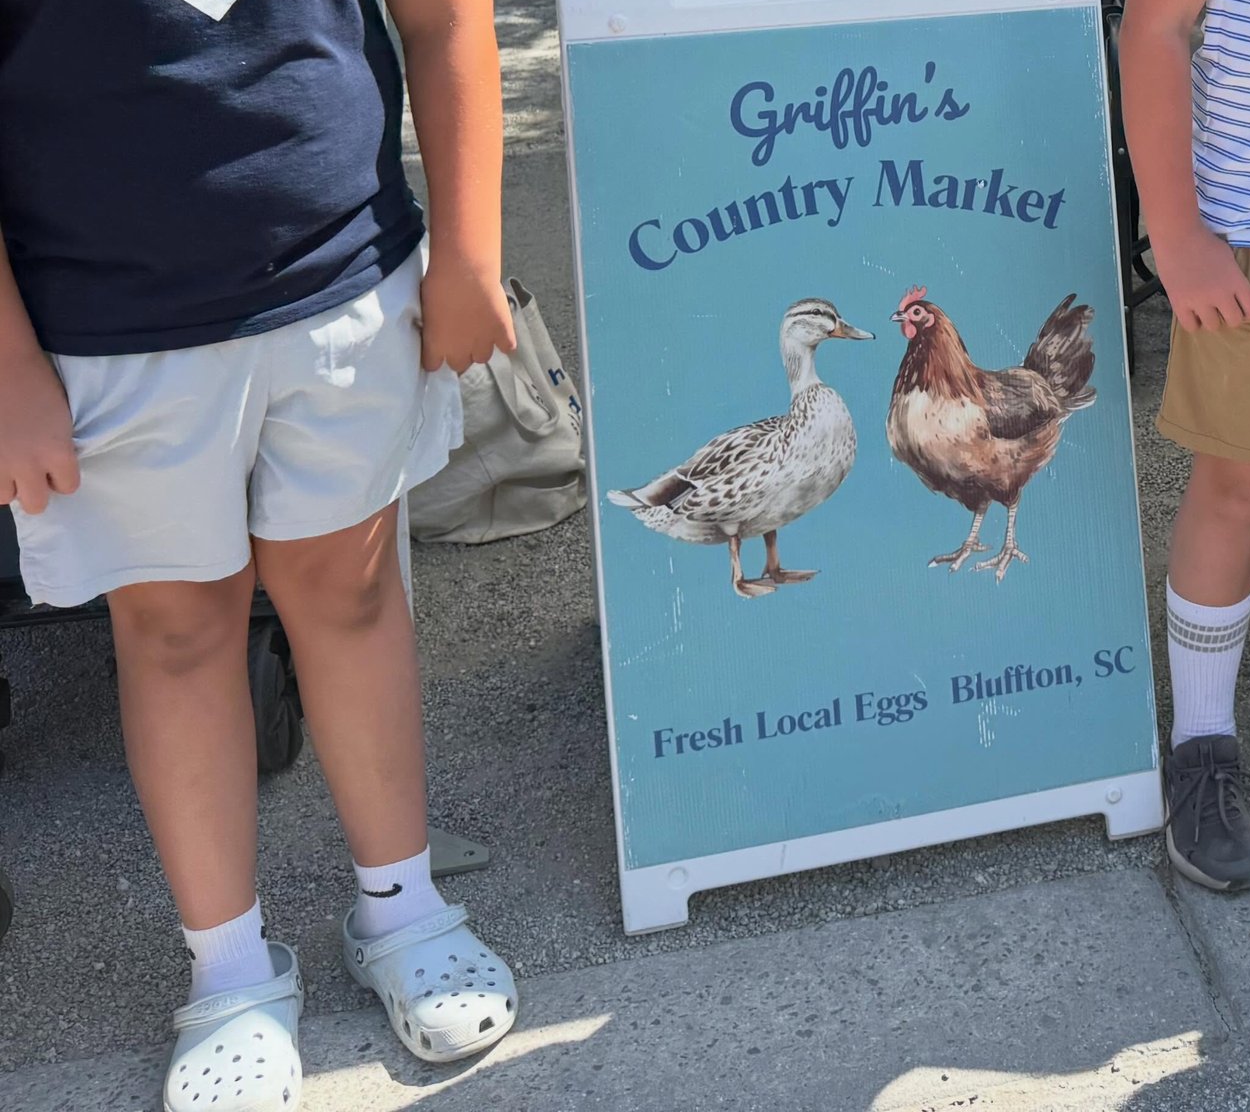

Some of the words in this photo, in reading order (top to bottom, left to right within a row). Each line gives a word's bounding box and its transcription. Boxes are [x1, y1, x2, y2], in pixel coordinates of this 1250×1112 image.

[729, 61, 971, 167] Griffin's
[627, 174, 855, 271] Country
[871, 158, 1067, 230] Market
[653, 717, 743, 758] Fresh
[757, 697, 842, 741] Local
[854, 687, 929, 726] Eggs
[950, 661, 1083, 705] Bluffton,
[1093, 645, 1136, 679] SC
